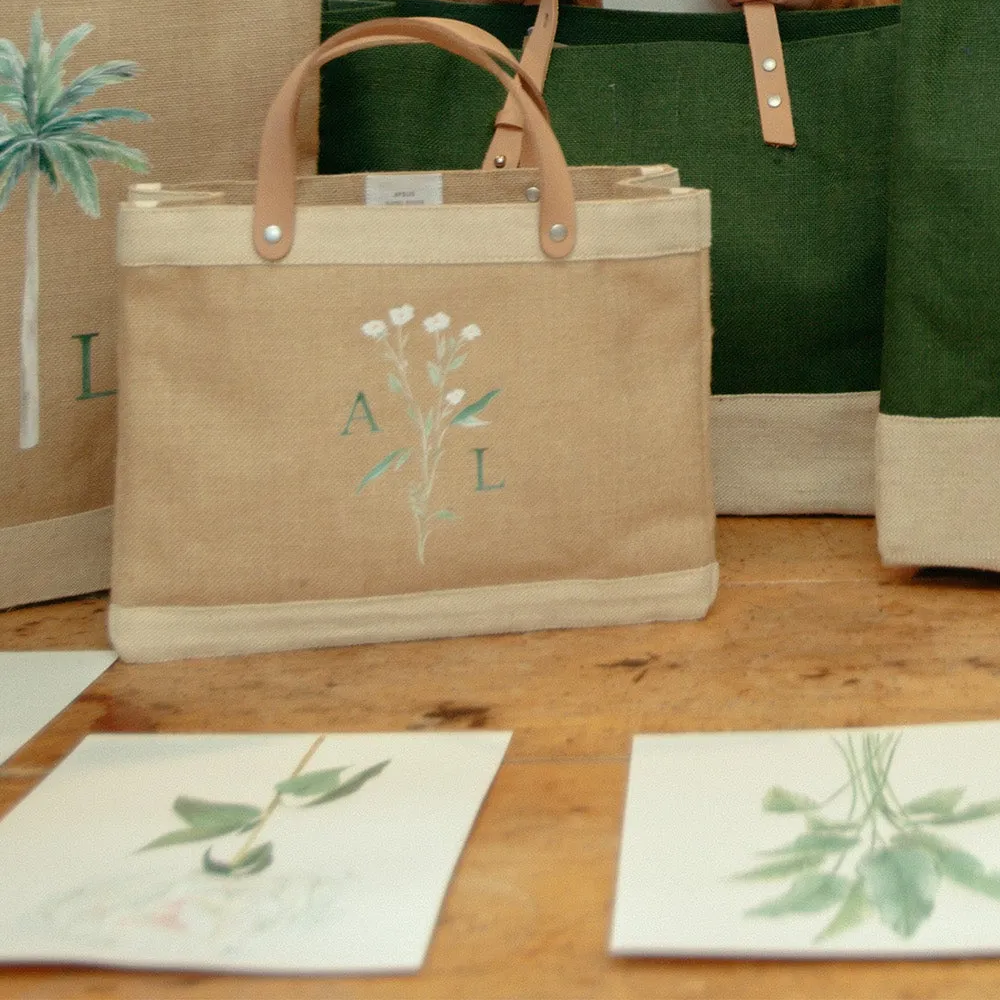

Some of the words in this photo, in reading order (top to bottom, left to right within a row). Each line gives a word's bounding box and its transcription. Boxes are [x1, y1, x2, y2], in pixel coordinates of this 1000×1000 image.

[72, 333, 117, 400] L
[340, 391, 380, 435] A
[473, 447, 505, 491] L
